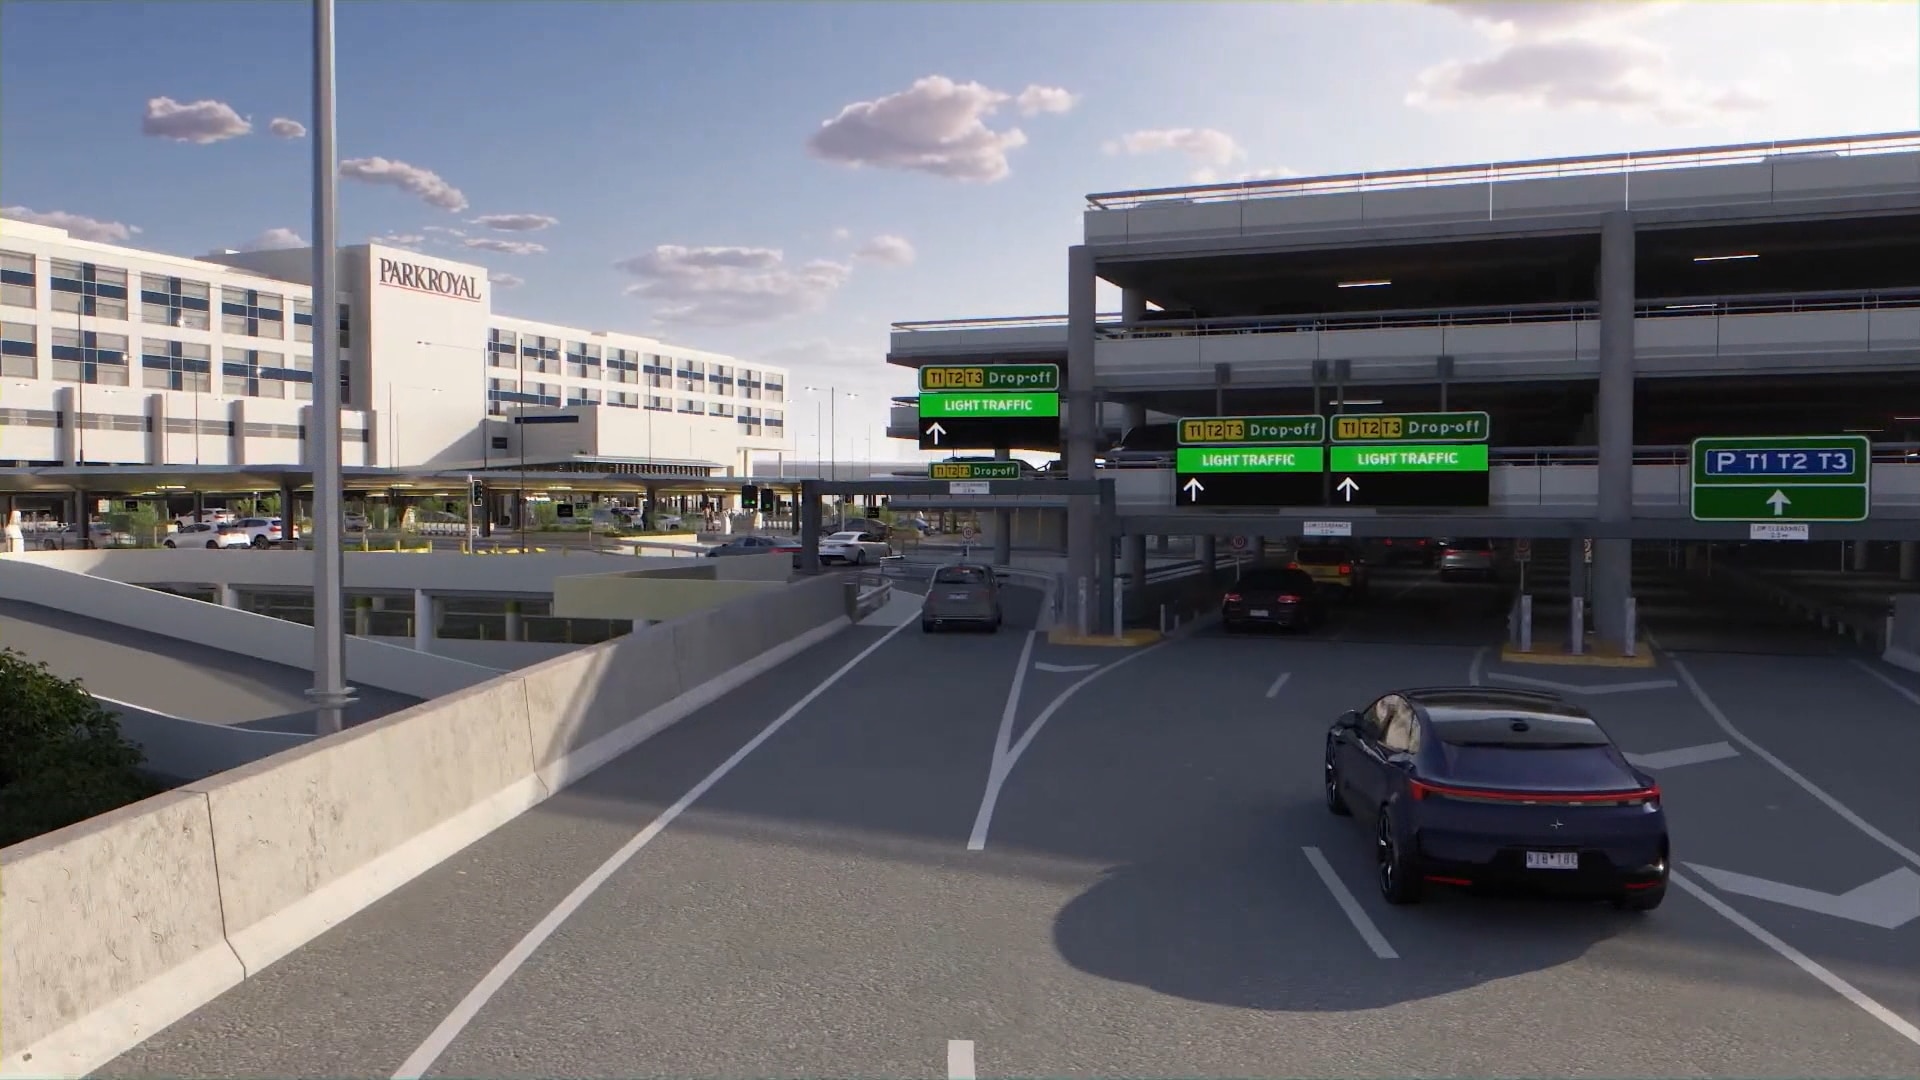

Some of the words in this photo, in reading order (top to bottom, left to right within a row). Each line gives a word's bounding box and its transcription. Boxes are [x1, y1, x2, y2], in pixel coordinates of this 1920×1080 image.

[379, 257, 482, 300] PARKROYAL
[930, 372, 942, 383] T1
[947, 372, 963, 383] T2
[966, 372, 983, 383] T3
[989, 371, 1052, 386] Drop-off
[944, 399, 980, 411] LIGHT
[982, 399, 1033, 411] TRAFFIC
[1189, 425, 1201, 437] T1
[1207, 424, 1223, 437] T2
[1226, 424, 1243, 436] T3
[1250, 422, 1317, 438] Drop-off
[1343, 422, 1355, 434] T1
[1362, 422, 1379, 434] T2
[1382, 421, 1401, 434] T3
[1408, 420, 1480, 435] Drop-off
[1202, 454, 1239, 467] LIGHT
[1241, 453, 1296, 466] TRAFFIC
[1357, 453, 1398, 465] LIGHT
[1400, 452, 1459, 465] TRAFFIC
[1717, 452, 1737, 472] P
[1746, 453, 1768, 470] T1
[1777, 453, 1808, 470] T2
[1818, 453, 1848, 470] T3
[948, 467, 958, 476] T2
[973, 466, 1015, 477] Drop-off
